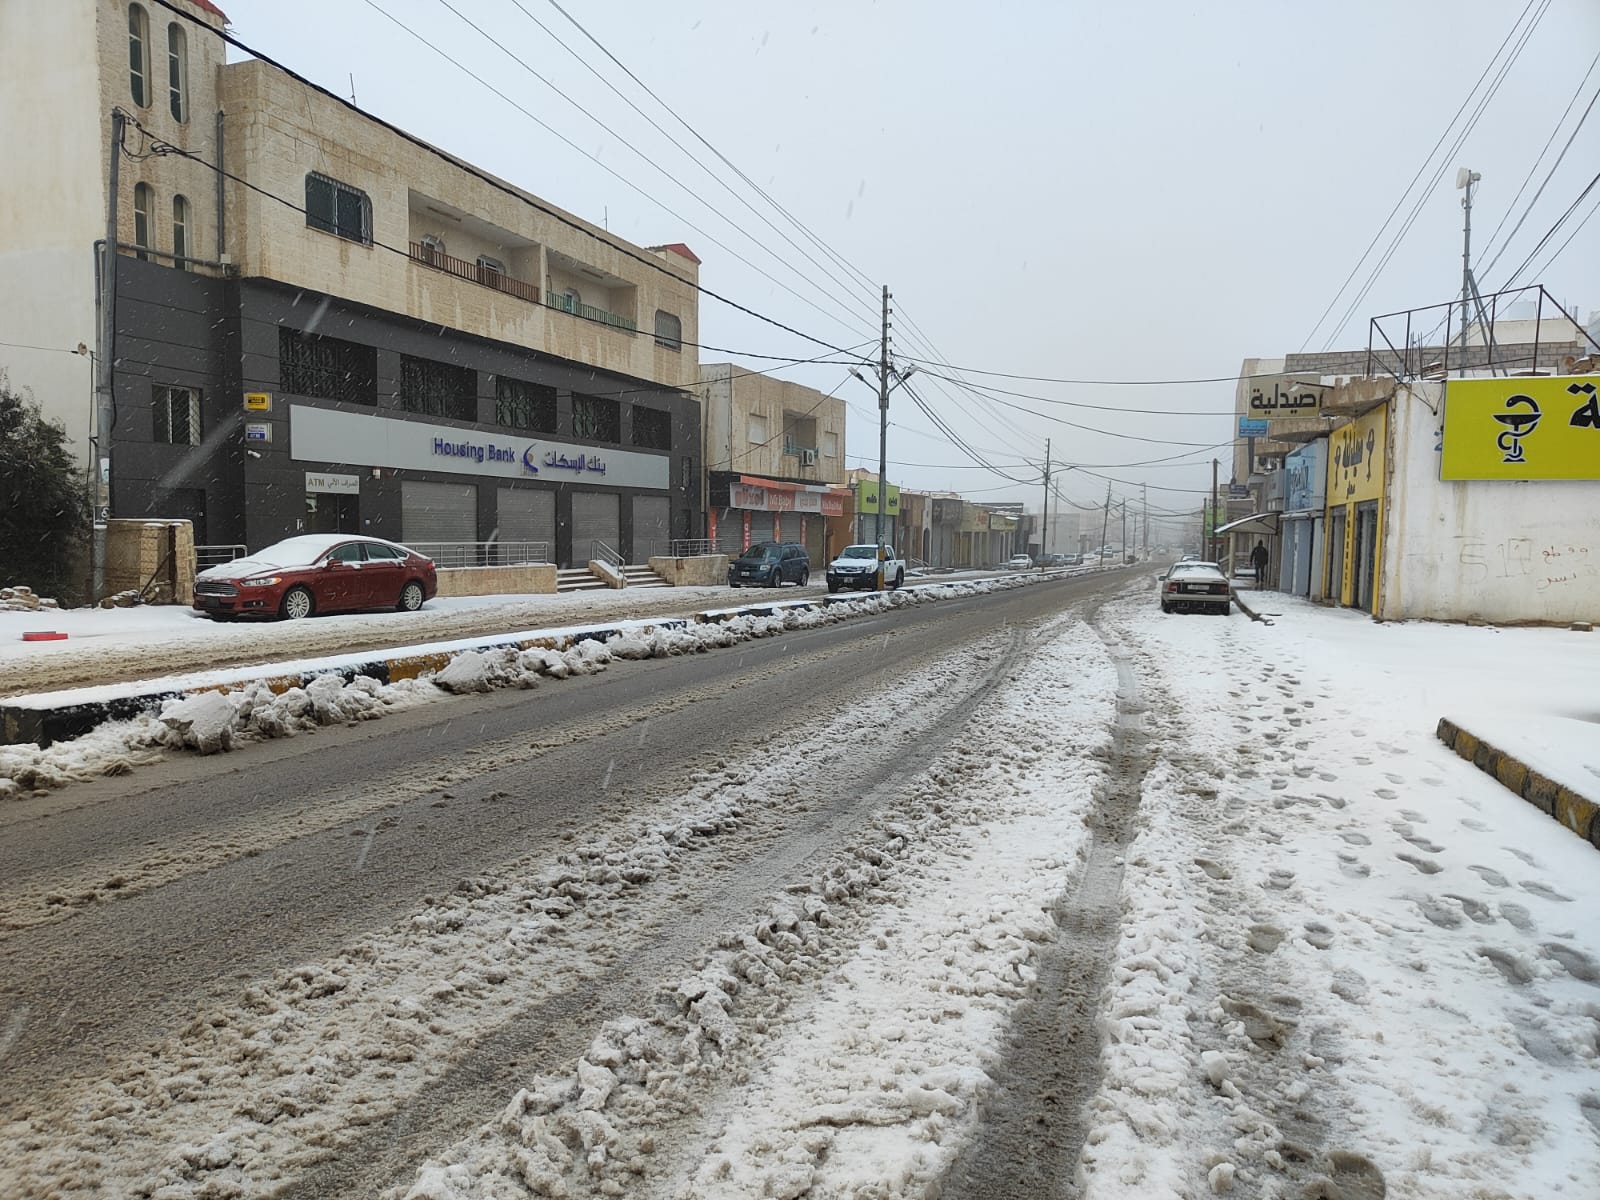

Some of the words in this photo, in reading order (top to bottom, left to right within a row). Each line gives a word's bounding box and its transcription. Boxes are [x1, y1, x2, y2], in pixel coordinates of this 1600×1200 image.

[1250, 383, 1317, 415] صيدلية
[434, 438, 484, 463] Housing
[488, 444, 515, 463] Bank
[587, 455, 606, 476] بنك
[308, 477, 325, 487] ATM
